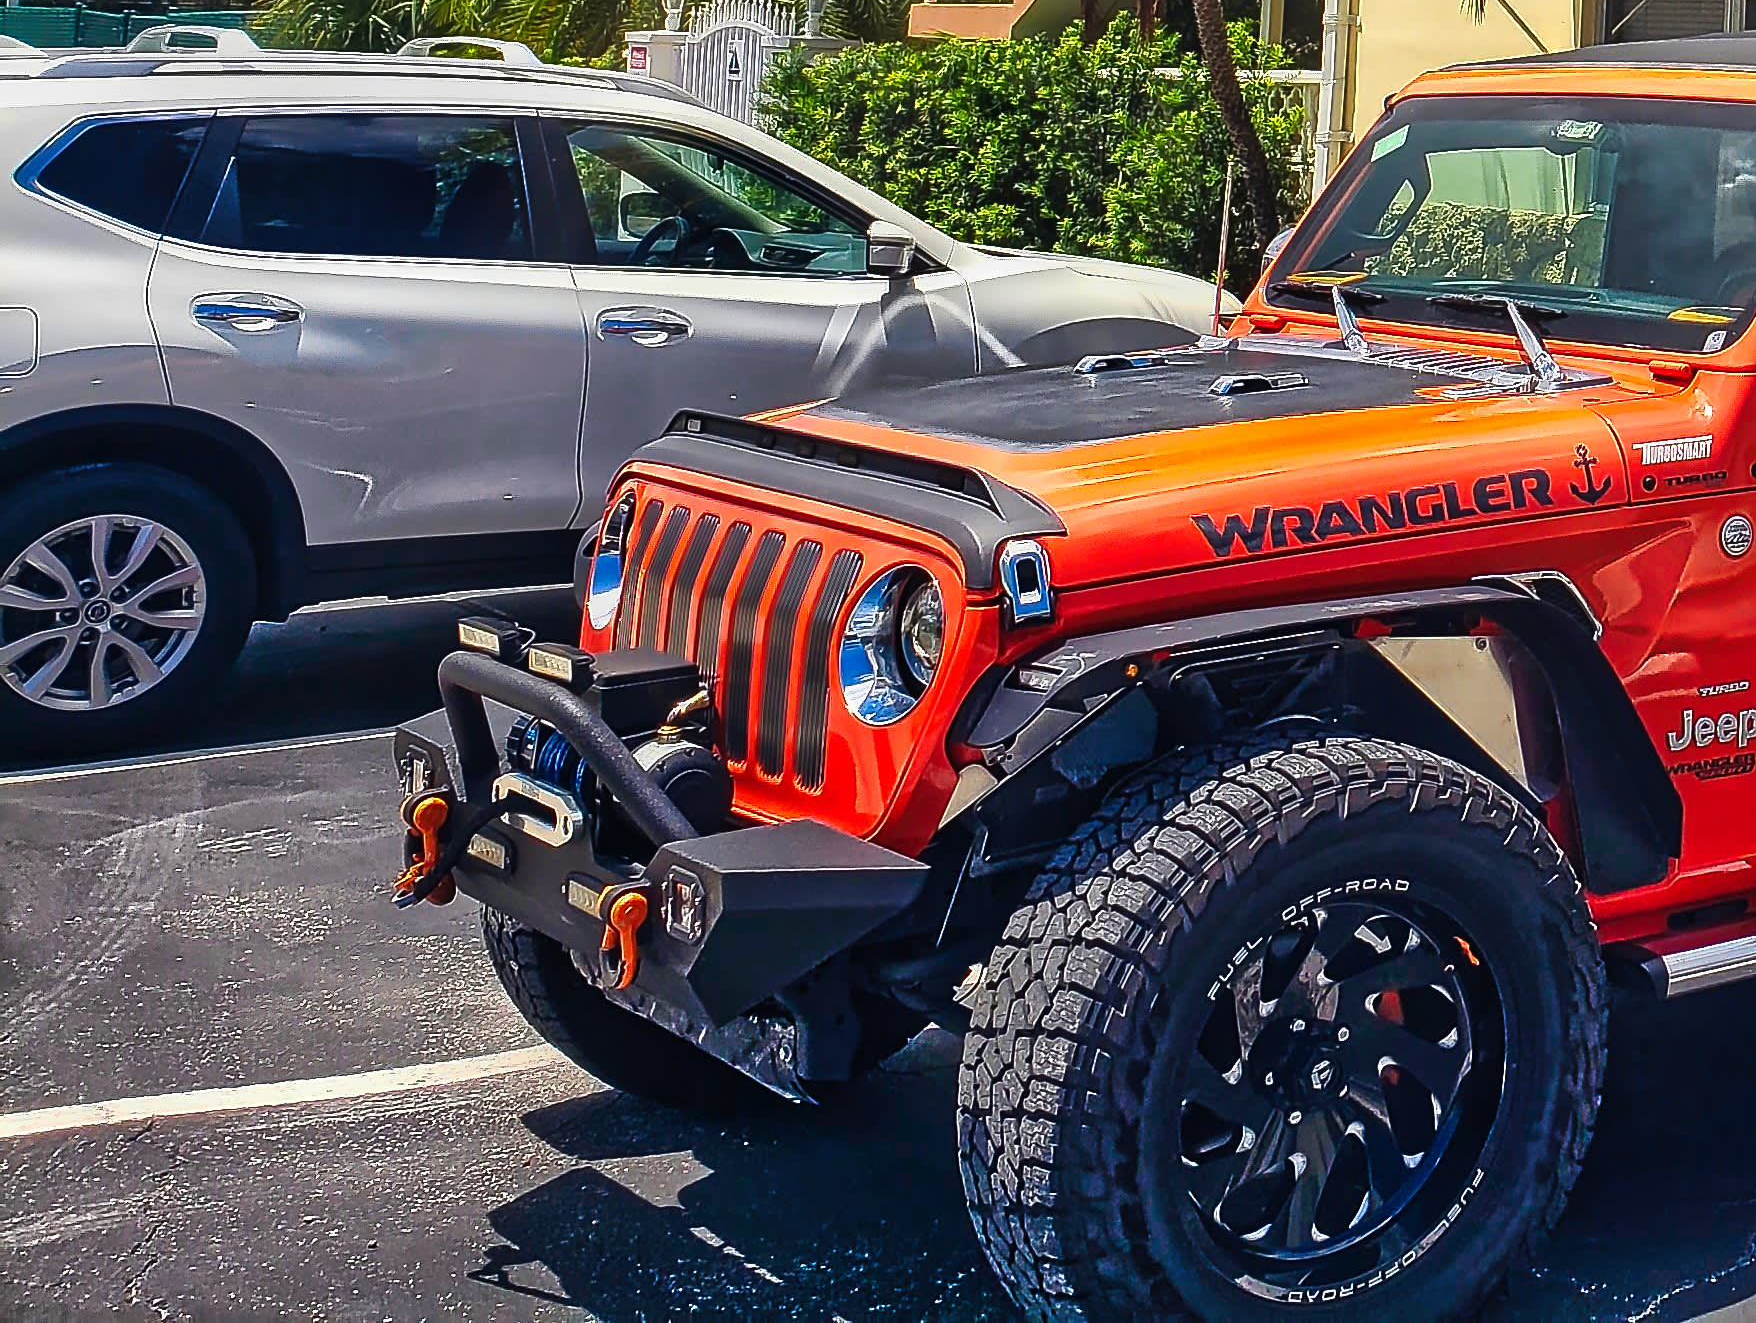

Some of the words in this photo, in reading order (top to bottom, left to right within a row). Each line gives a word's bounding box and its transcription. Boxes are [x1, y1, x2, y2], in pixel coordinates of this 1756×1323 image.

[1632, 434, 1713, 466] TURBOSMART
[1191, 467, 1555, 558] WRANGLER
[1698, 681, 1750, 697] TURBO
[1207, 936, 1264, 1001] FUEL
[1281, 878, 1411, 922] OFF-ROAD
[1287, 1249, 1416, 1304] OFF-ROAD
